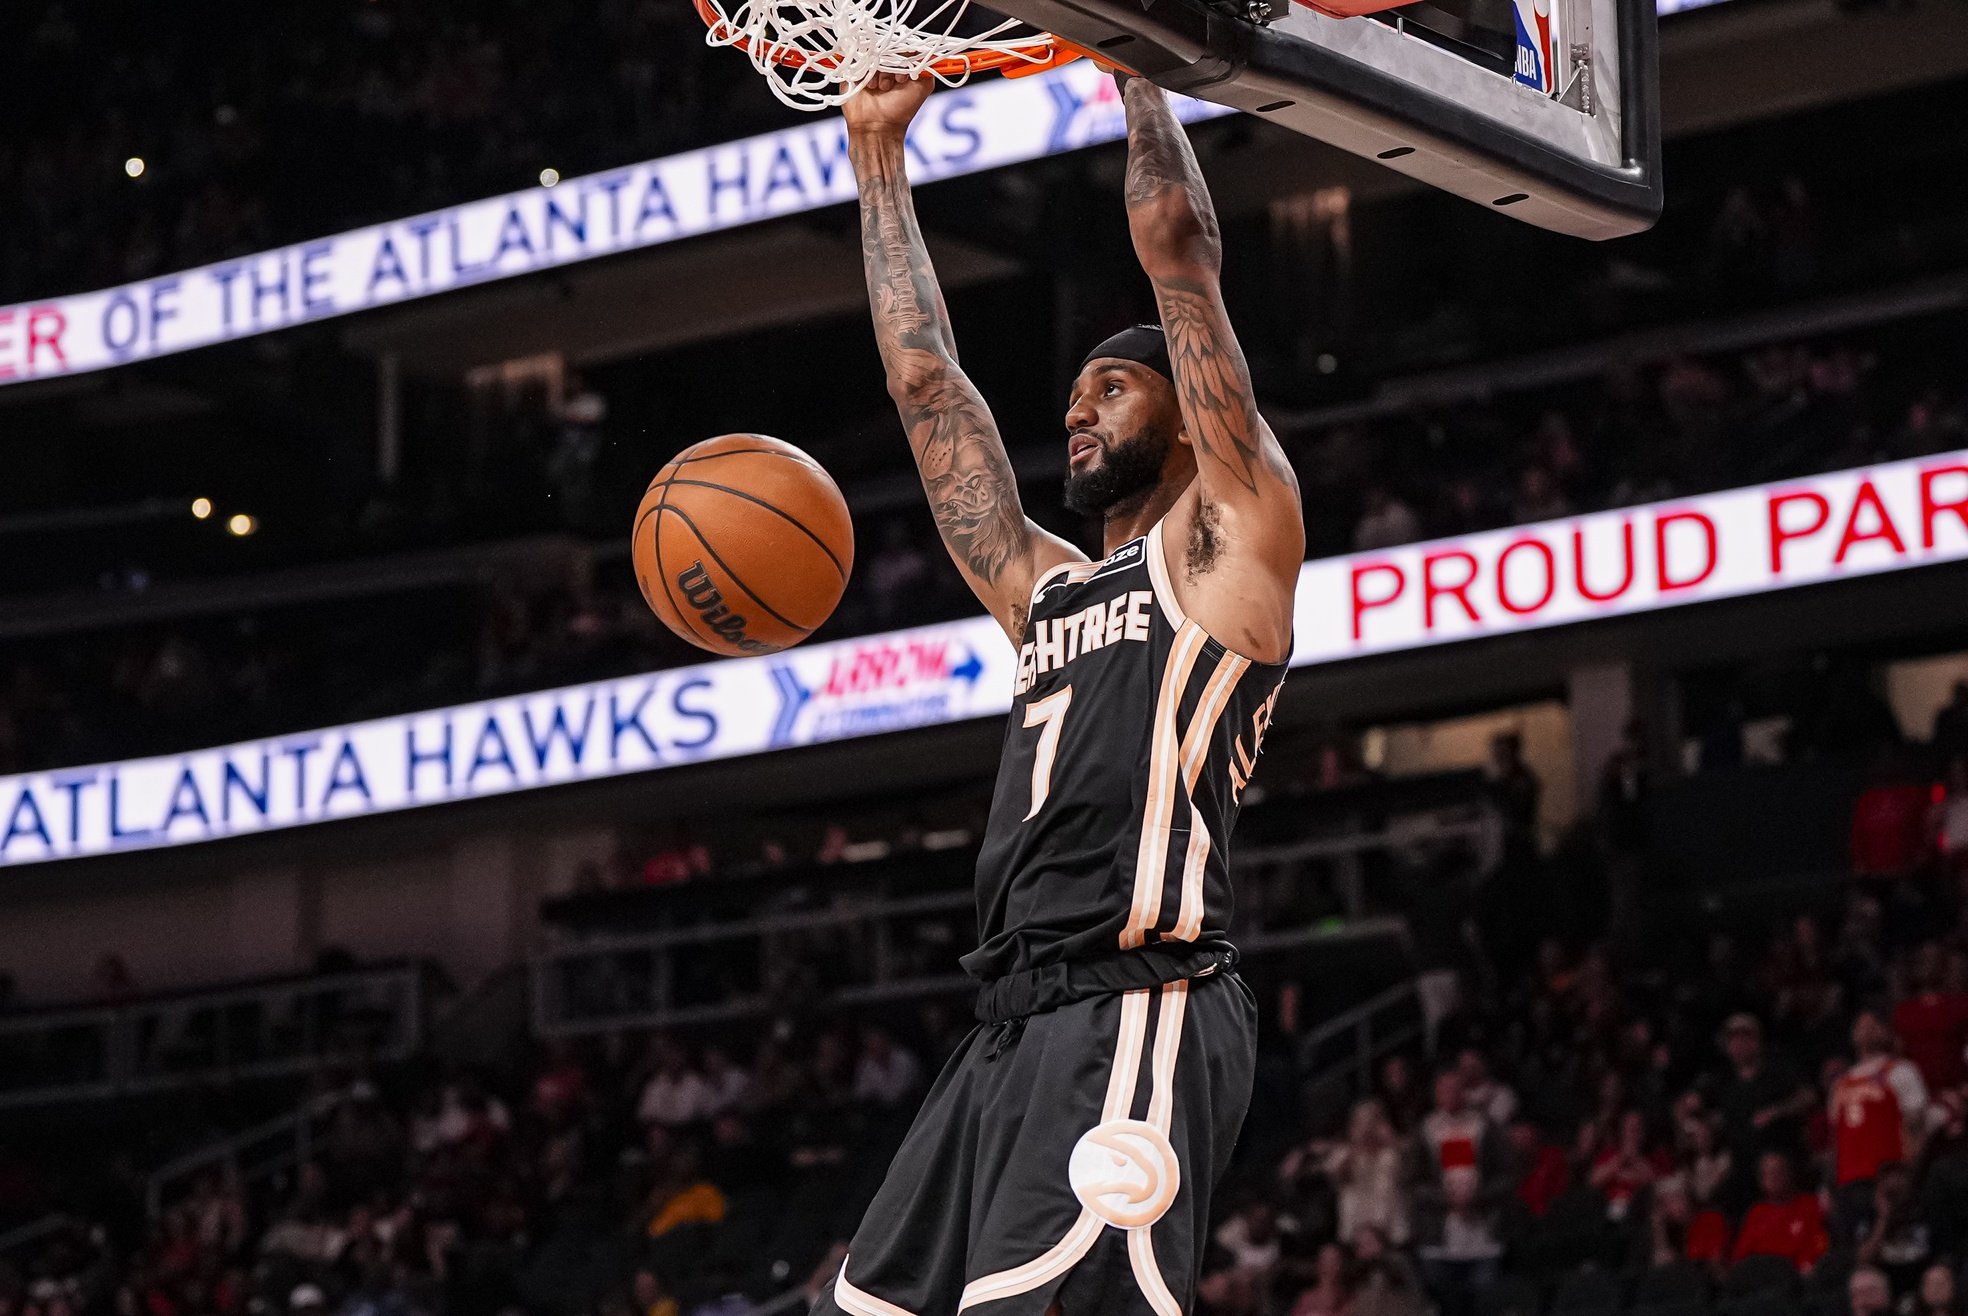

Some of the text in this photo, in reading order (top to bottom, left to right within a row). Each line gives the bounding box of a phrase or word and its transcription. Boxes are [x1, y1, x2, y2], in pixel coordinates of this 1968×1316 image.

[1515, 44, 1537, 80] NBA
[102, 276, 180, 360] OF
[210, 239, 336, 331] THE
[367, 170, 682, 293] ATLANTA
[1348, 463, 1968, 642] PROUD PAR
[0, 735, 374, 852] ATLANTA
[404, 673, 720, 793] HAWKS
[1022, 684, 1073, 823] 7
